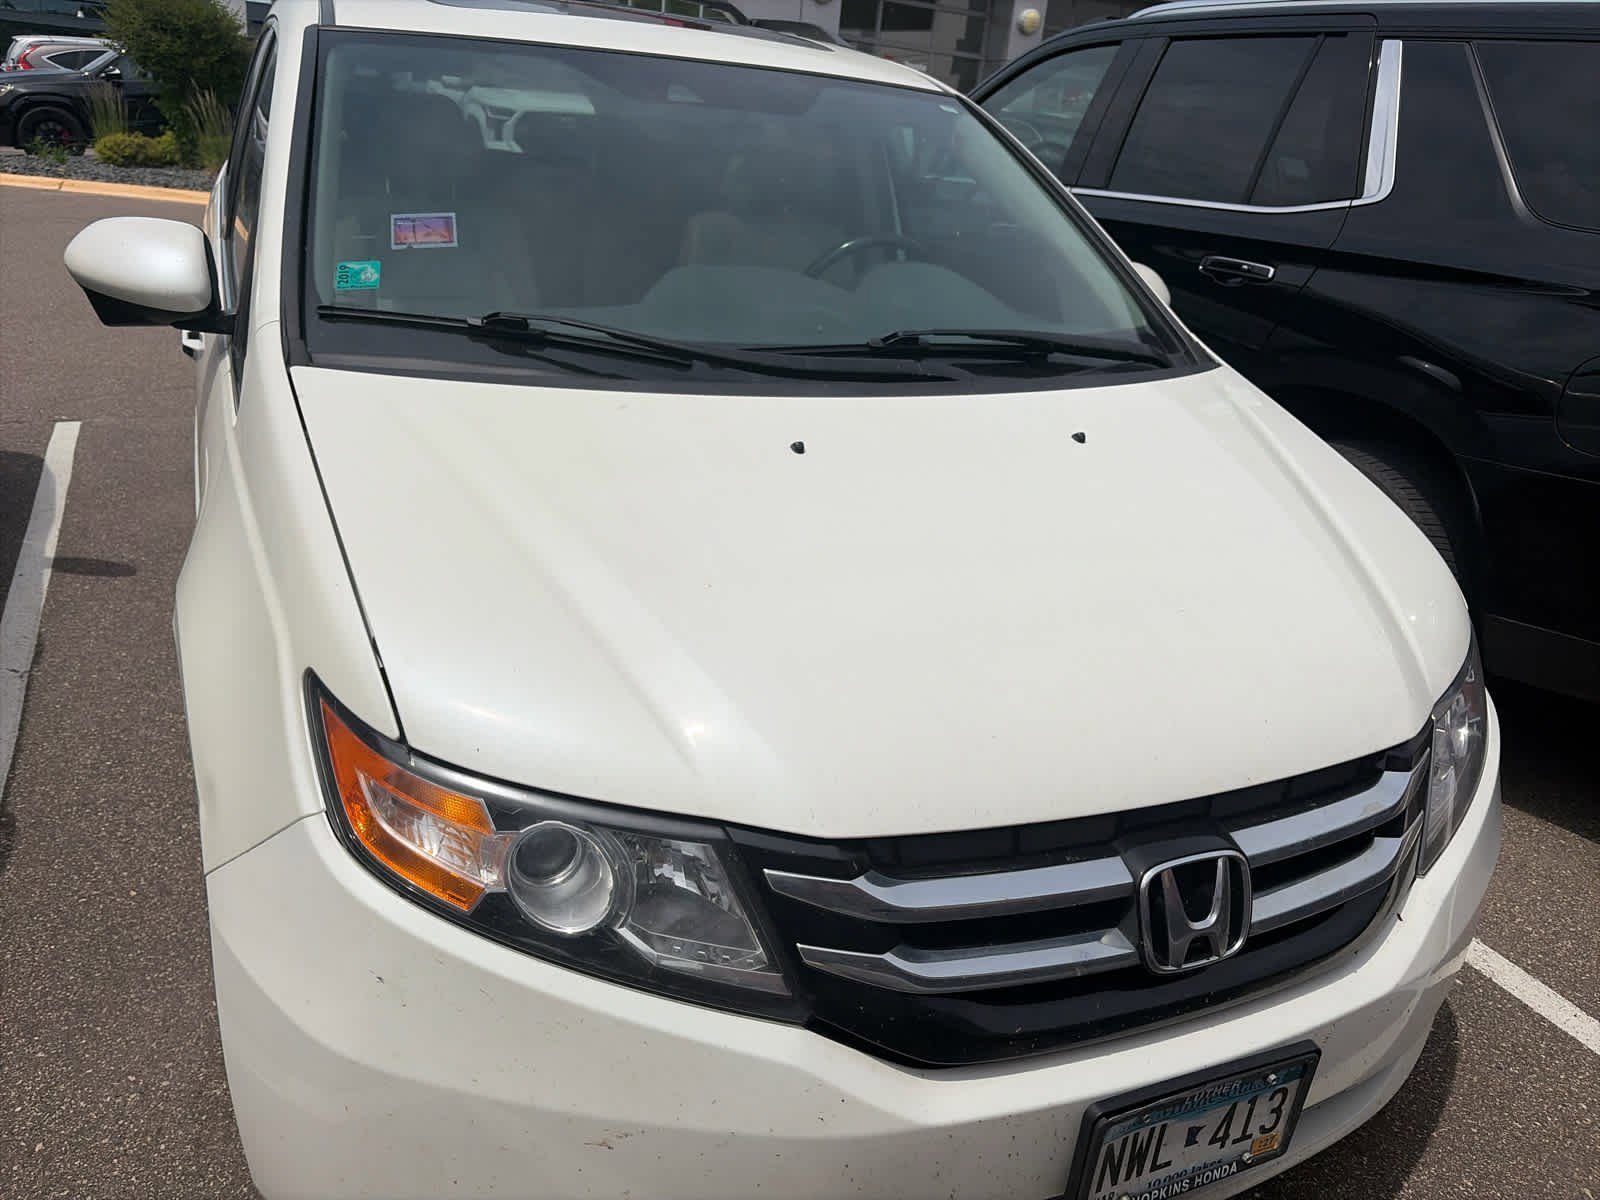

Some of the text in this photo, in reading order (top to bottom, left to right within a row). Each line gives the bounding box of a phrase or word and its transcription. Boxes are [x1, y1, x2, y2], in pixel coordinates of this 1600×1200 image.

[338, 265, 350, 285] 2019
[1096, 1086, 1289, 1194] NWL 413
[1193, 1160, 1238, 1188] HONDA
